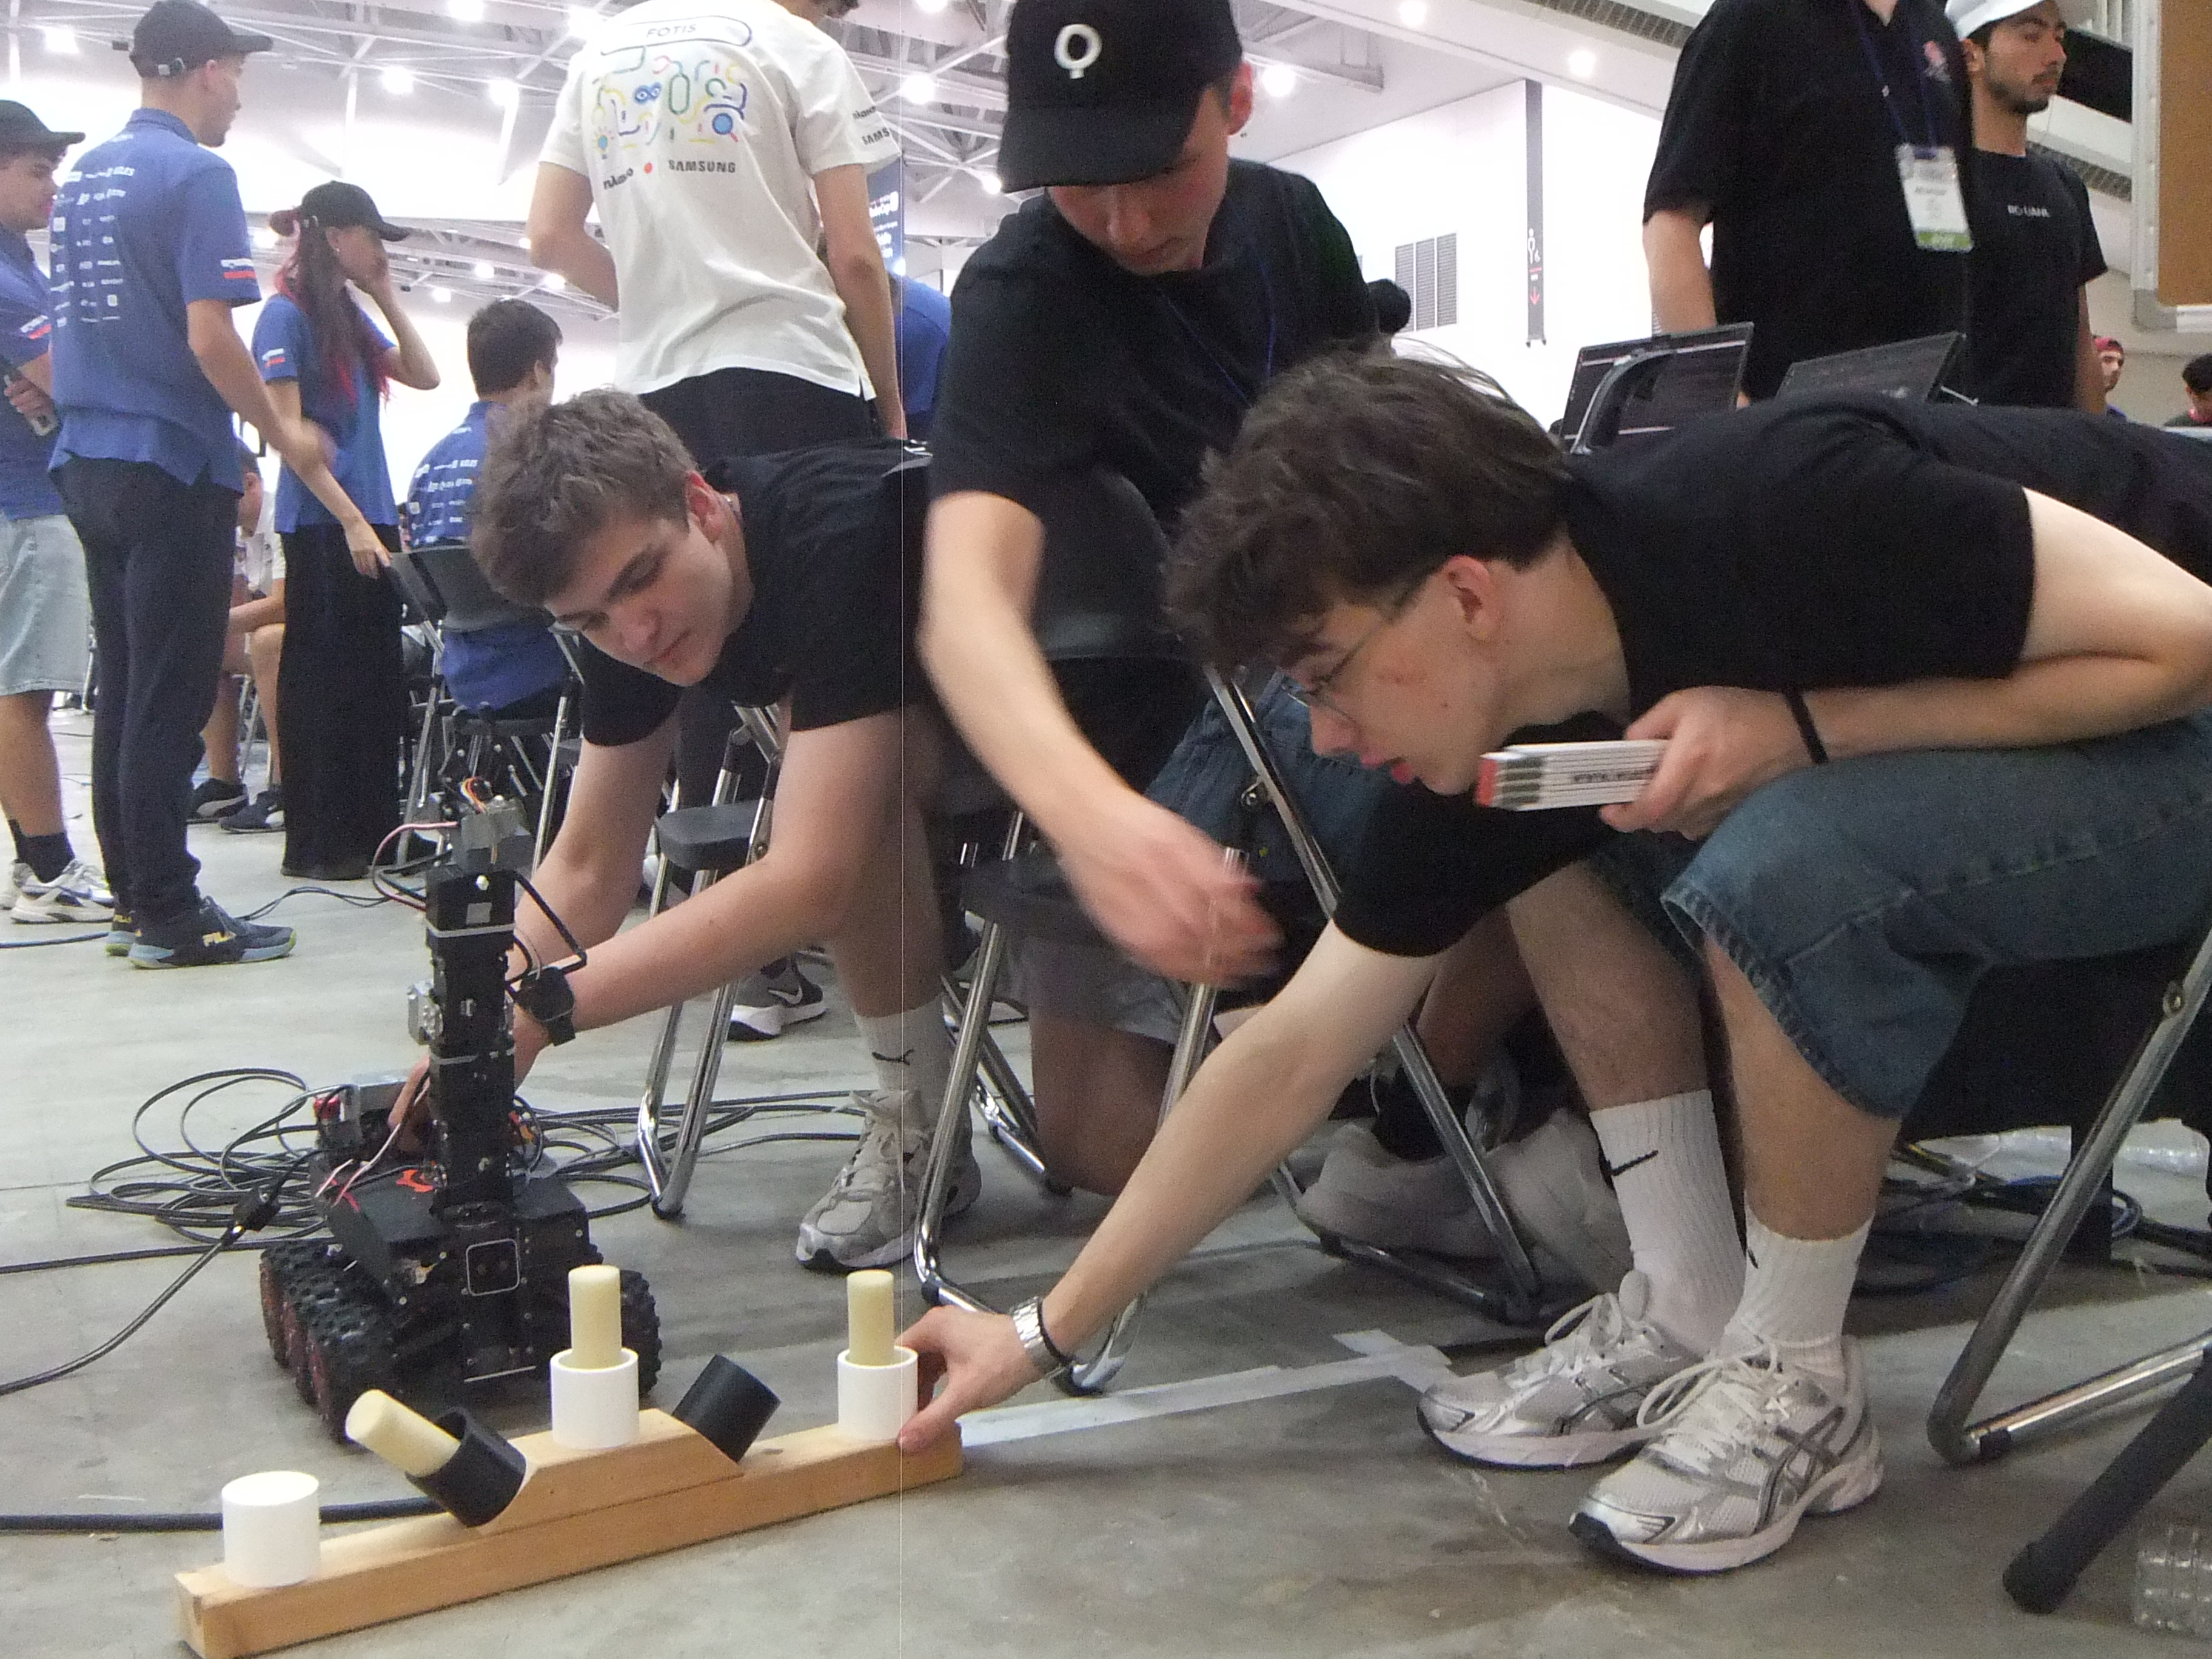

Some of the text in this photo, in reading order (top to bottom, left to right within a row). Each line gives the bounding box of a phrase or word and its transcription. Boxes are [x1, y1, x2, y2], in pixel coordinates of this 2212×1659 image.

[646, 24, 697, 38] FOTIS
[862, 127, 890, 146] SAMS
[668, 159, 736, 173] SAMSUNG
